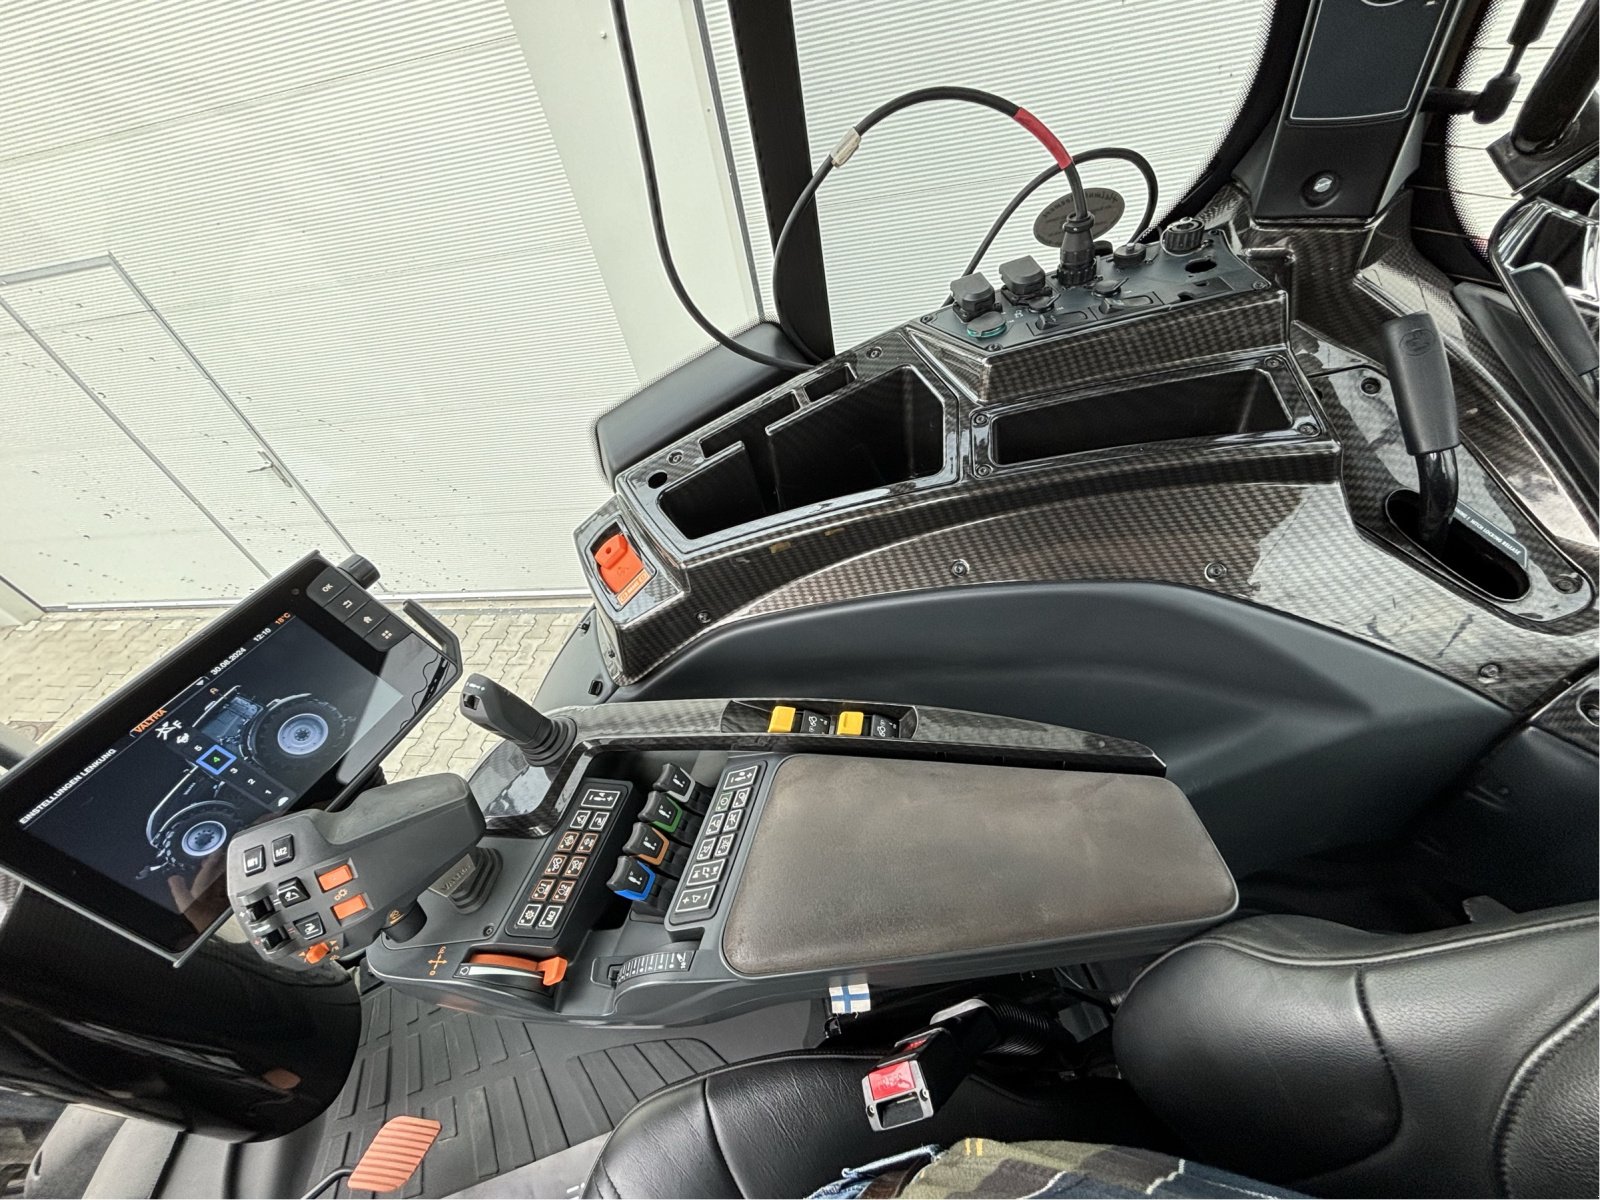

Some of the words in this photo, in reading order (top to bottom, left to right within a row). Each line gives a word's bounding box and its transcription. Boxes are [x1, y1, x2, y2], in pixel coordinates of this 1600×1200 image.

[322, 583, 334, 592] OK
[210, 647, 247, 675] 30.08.2024
[253, 627, 272, 642] 12:10
[133, 708, 168, 733] VALTRA
[19, 774, 82, 824] EINSTELLUNGEN
[80, 748, 117, 776] LENKUNG
[275, 847, 288, 857] M2
[247, 858, 258, 868] M1
[546, 910, 556, 922] M3
